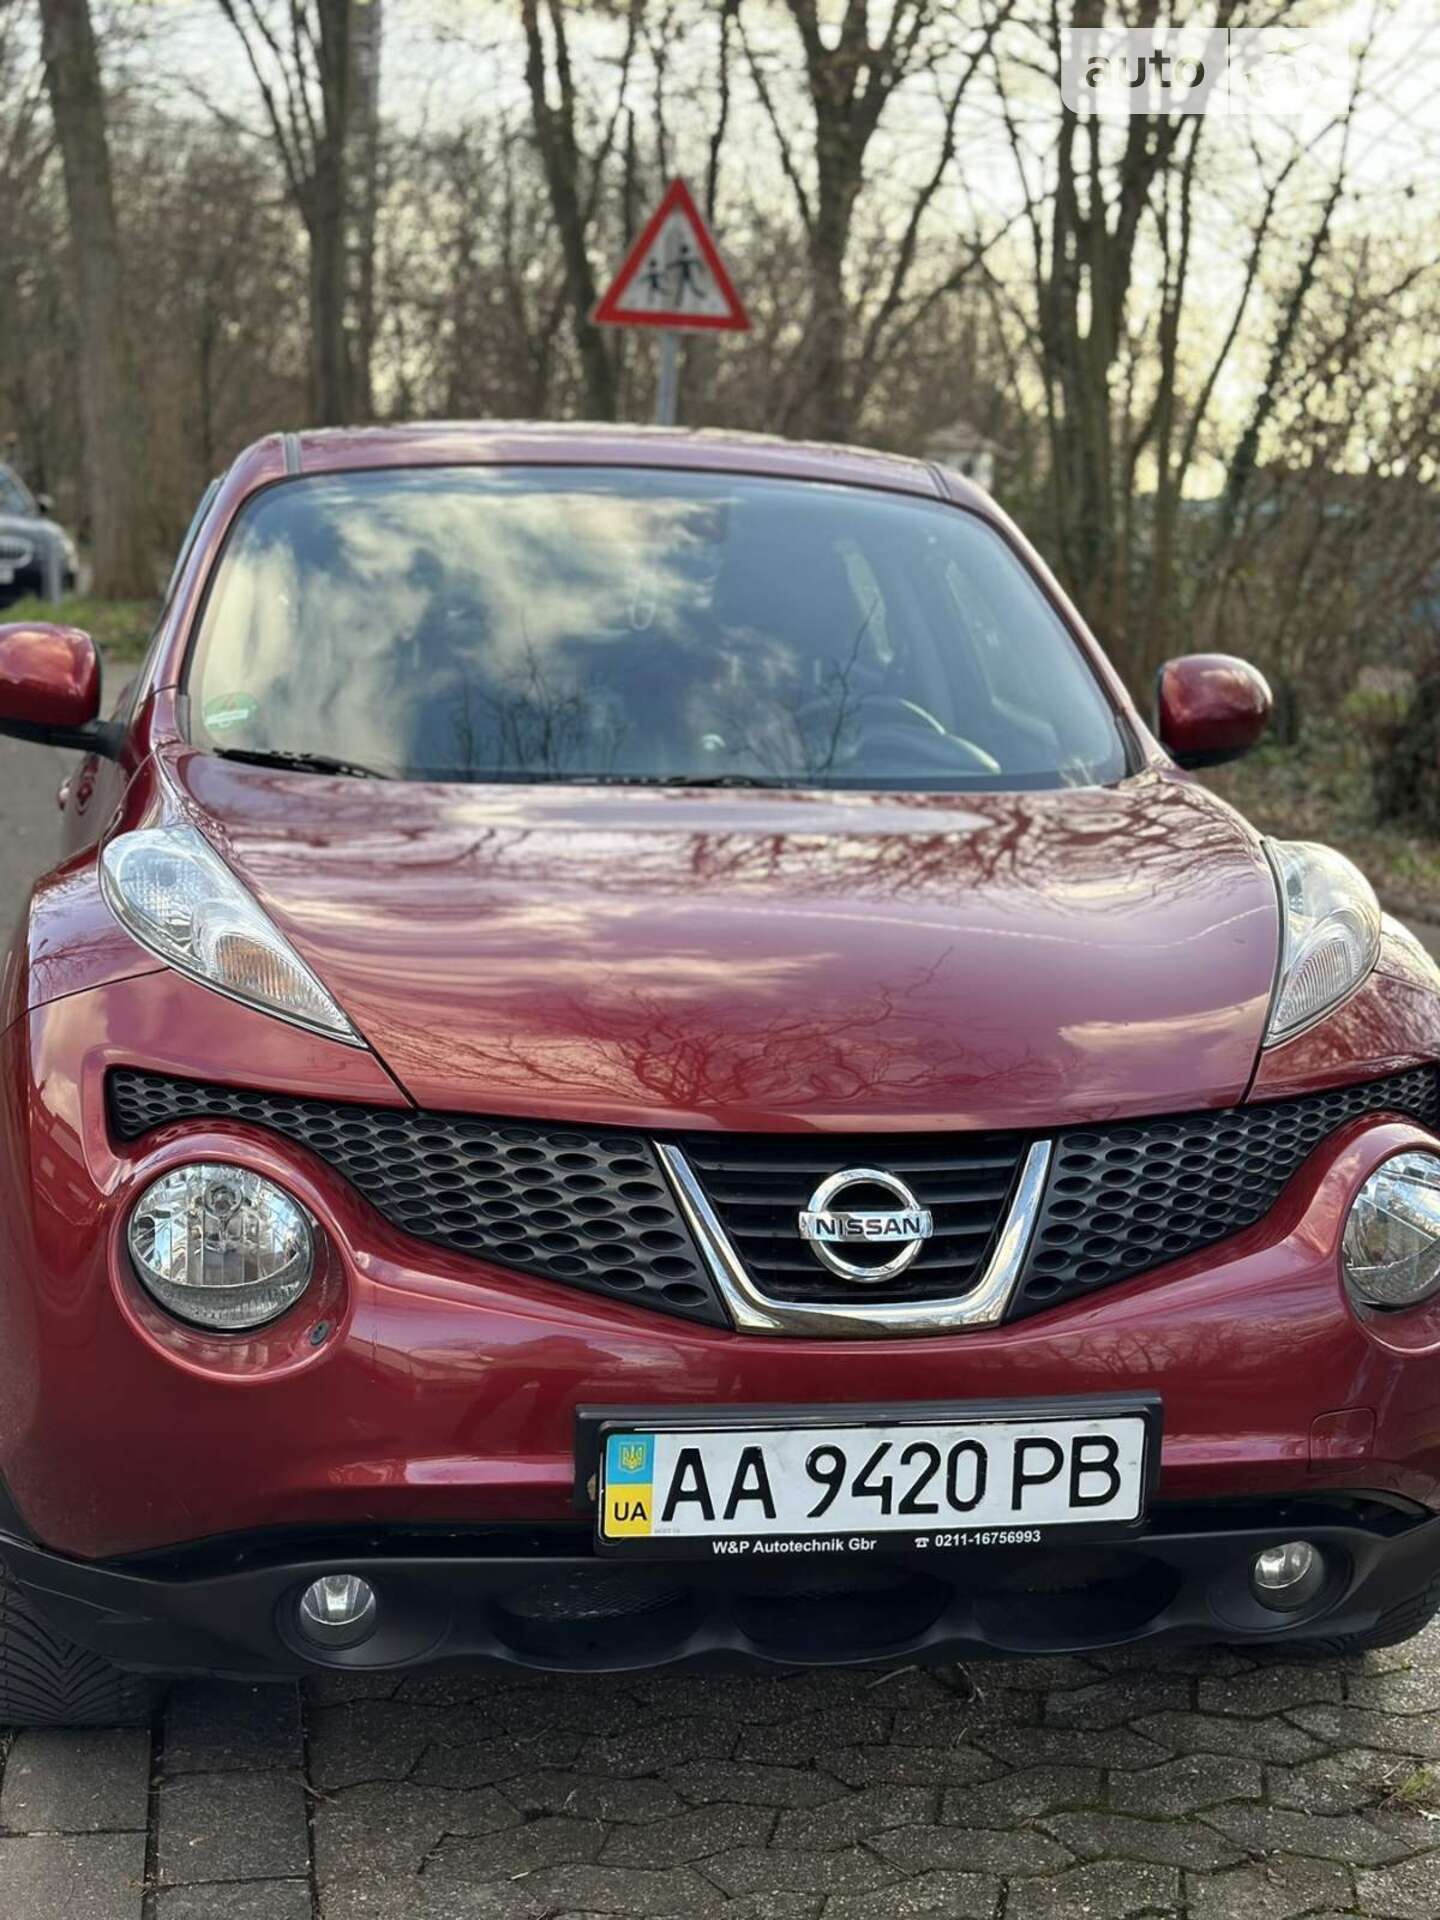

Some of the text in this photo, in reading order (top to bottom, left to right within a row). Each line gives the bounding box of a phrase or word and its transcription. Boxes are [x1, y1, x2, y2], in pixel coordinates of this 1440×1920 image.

[815, 1217, 921, 1236] NISSAN
[660, 1434, 1122, 1522] AA 9420 PB
[613, 1502, 648, 1521] UA
[712, 1529, 1042, 1554] W&P Autotechnik Gbr 0211-16756993
